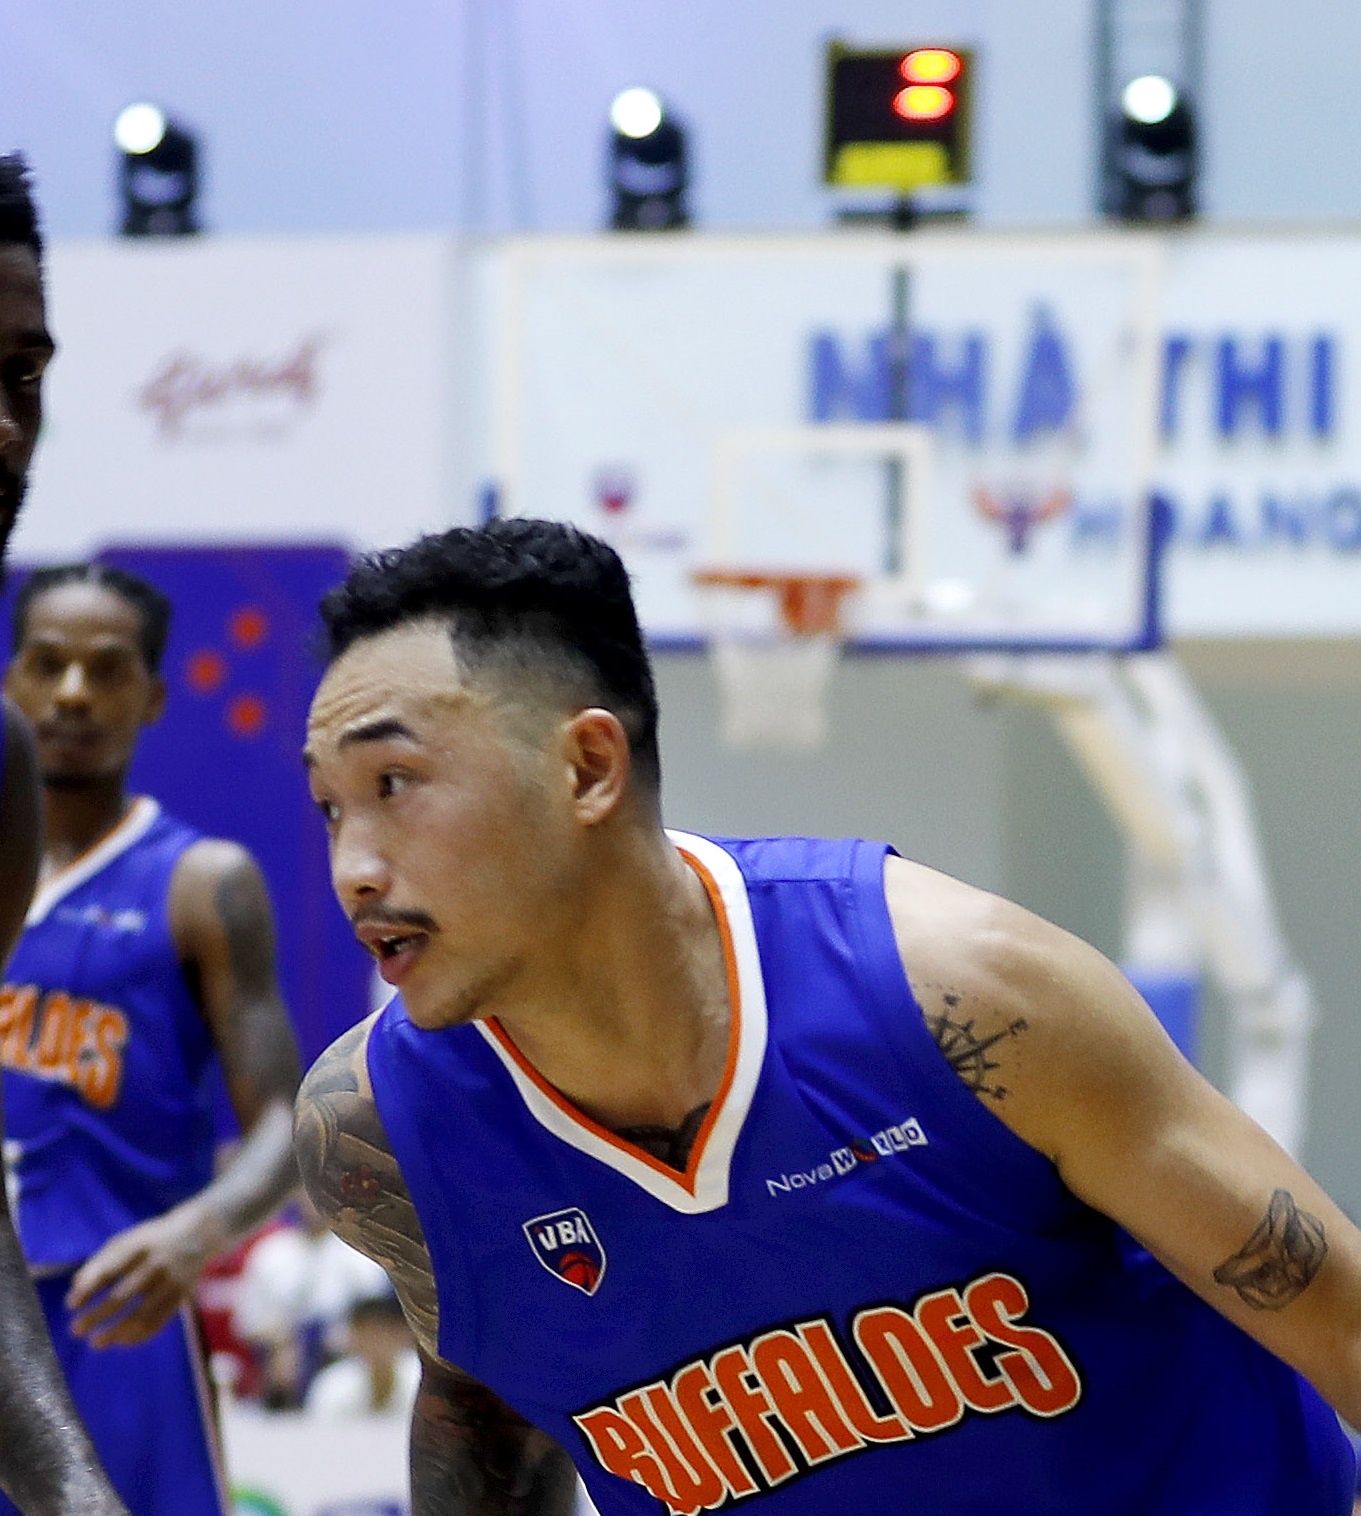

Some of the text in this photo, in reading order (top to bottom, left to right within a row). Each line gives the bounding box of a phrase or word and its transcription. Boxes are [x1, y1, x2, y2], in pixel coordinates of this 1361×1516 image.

[806, 300, 1080, 448] NHÀ
[1130, 330, 1338, 447] THI
[537, 1215, 592, 1252] VBA
